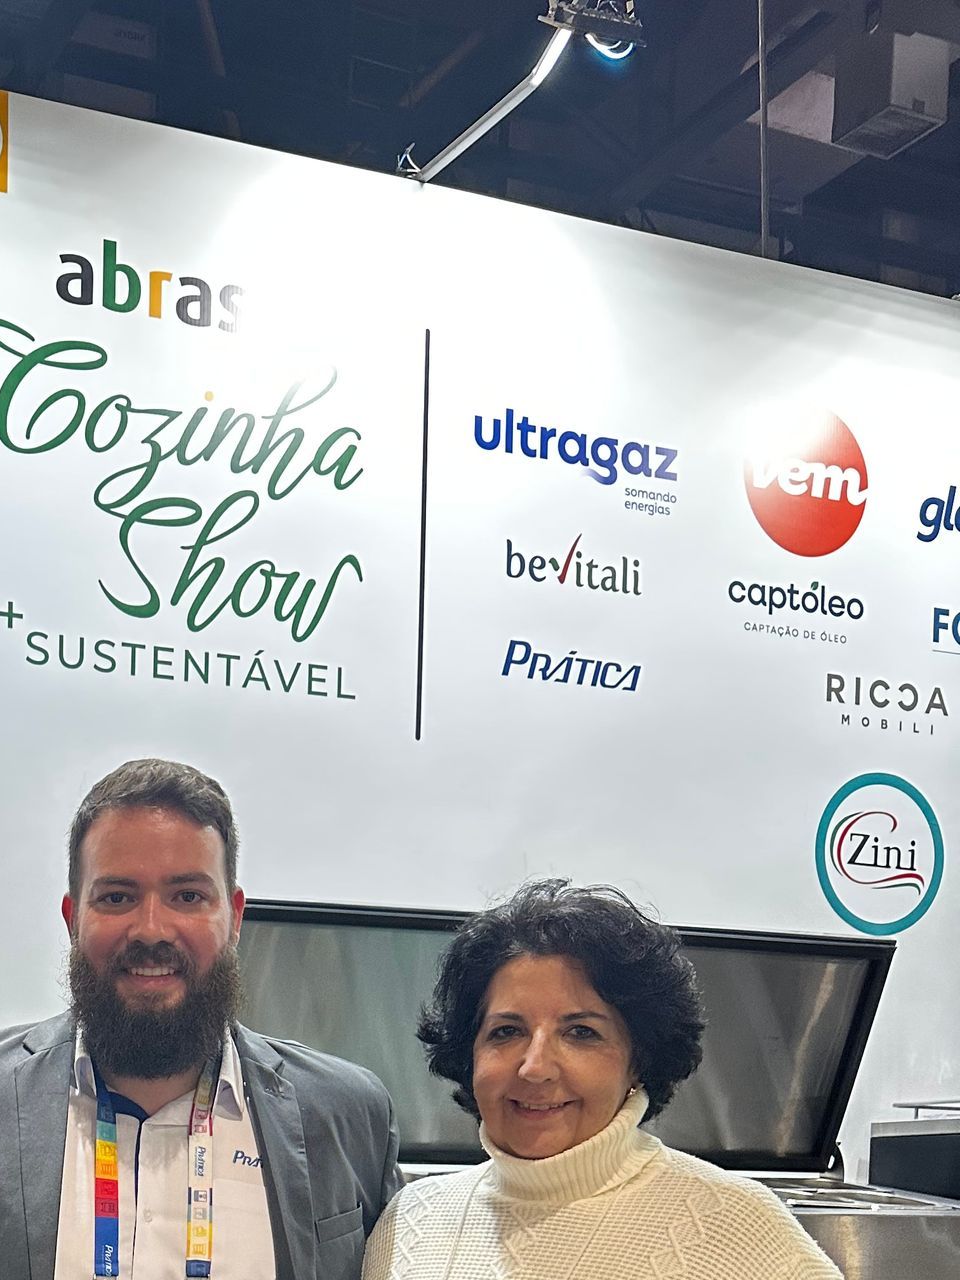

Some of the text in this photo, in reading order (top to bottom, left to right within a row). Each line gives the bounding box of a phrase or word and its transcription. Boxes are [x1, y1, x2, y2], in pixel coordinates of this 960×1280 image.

[474, 408, 678, 486] ultragaz
[624, 487, 677, 503] somando
[746, 456, 868, 506] vem
[624, 499, 671, 516] energias
[98, 490, 363, 643] Show
[728, 580, 865, 620] captóleo
[743, 621, 848, 644] CAPTAÇÃO DE ÓLEO
[25, 631, 357, 700] SUSTENTÁVEL
[501, 640, 642, 692] PRÁTICA
[841, 714, 934, 736] MOBILI
[846, 832, 917, 872] Zini
